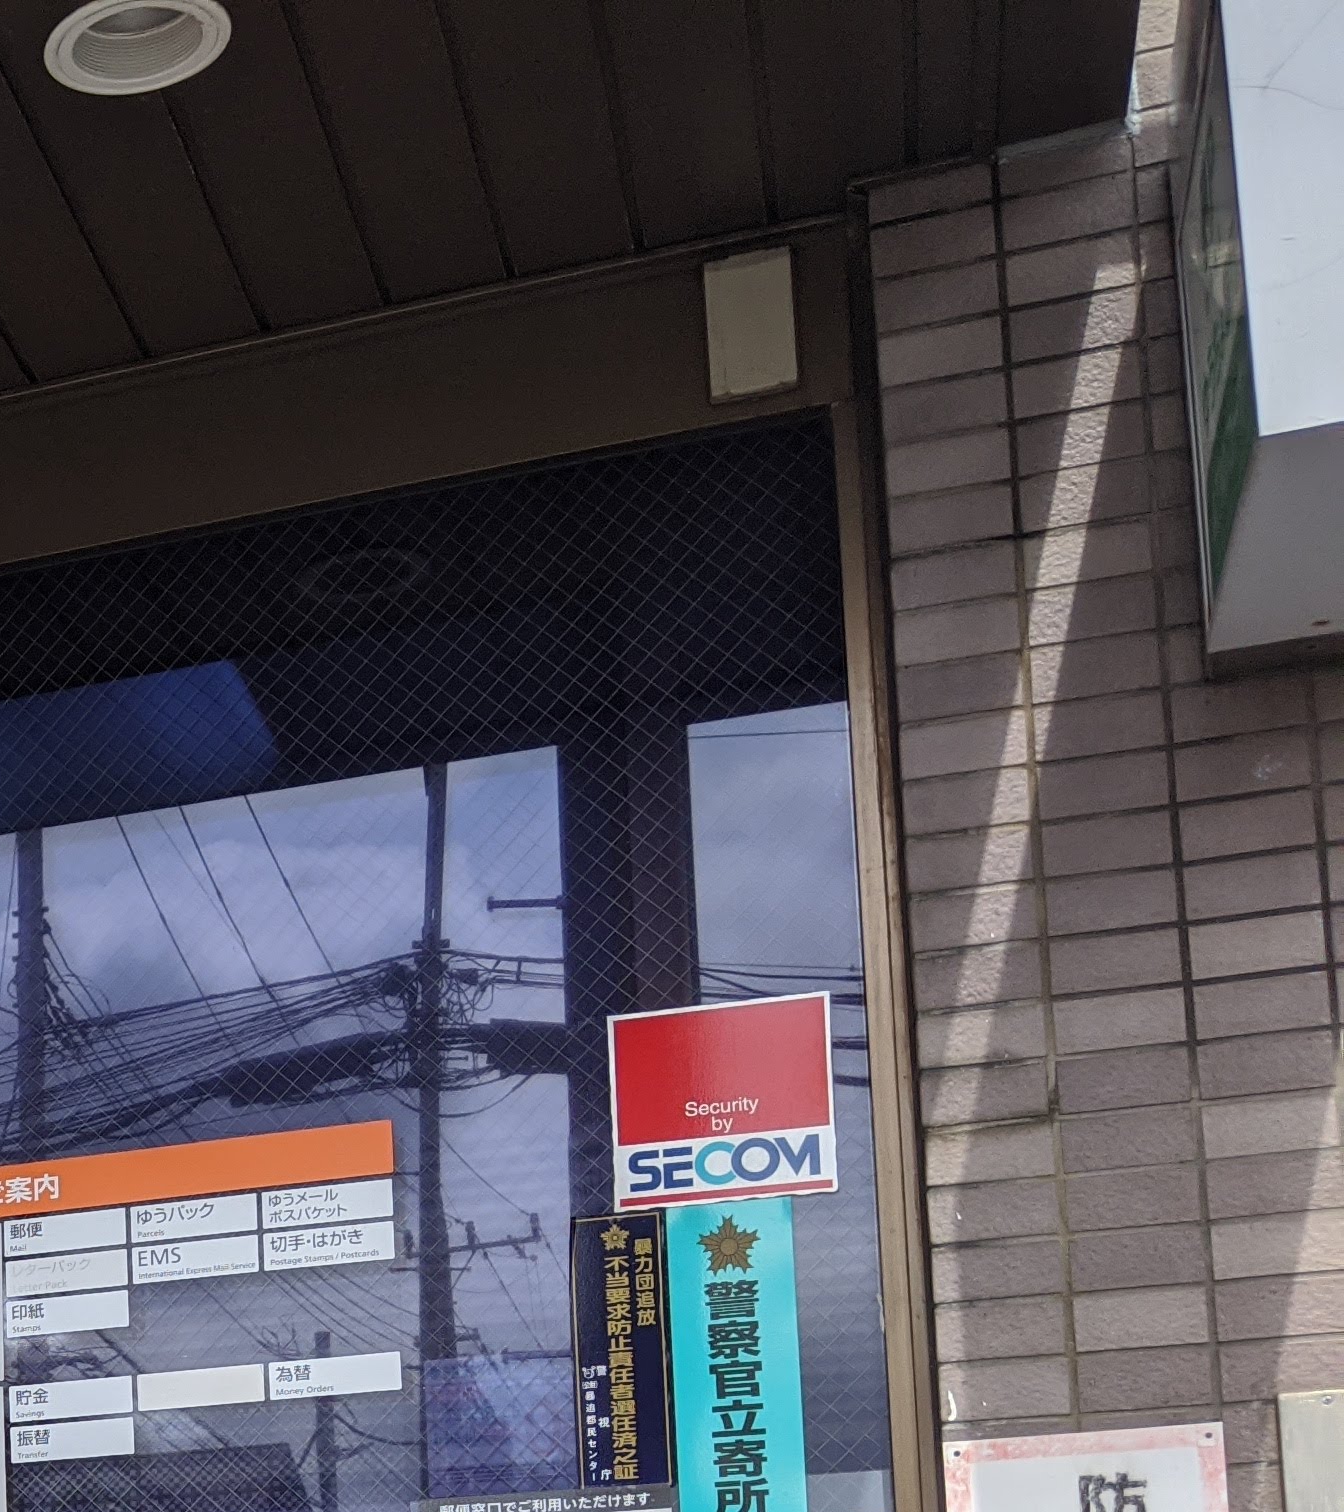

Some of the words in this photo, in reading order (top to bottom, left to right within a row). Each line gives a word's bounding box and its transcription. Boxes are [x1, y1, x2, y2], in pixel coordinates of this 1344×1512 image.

[685, 1096, 760, 1117] Security
[711, 1116, 733, 1132] by
[628, 1134, 821, 1192] SECOM
[268, 1189, 339, 1208] ゆうメール
[137, 1202, 215, 1225] ゆうパック
[10, 1222, 43, 1239] 郵便
[270, 1230, 364, 1252] 切手・はがき
[138, 1247, 181, 1267] EMS
[270, 1256, 303, 1267] Postage
[341, 1248, 381, 1259] Postcards
[138, 1268, 185, 1280] International
[633, 1237, 657, 1326] 暴力団追放
[11, 1303, 45, 1320] 印紙
[275, 1362, 312, 1384] 為替
[15, 1388, 49, 1406] 貯金
[276, 1386, 305, 1398] Money
[306, 1383, 334, 1395] Orders
[17, 1429, 51, 1447] 振替
